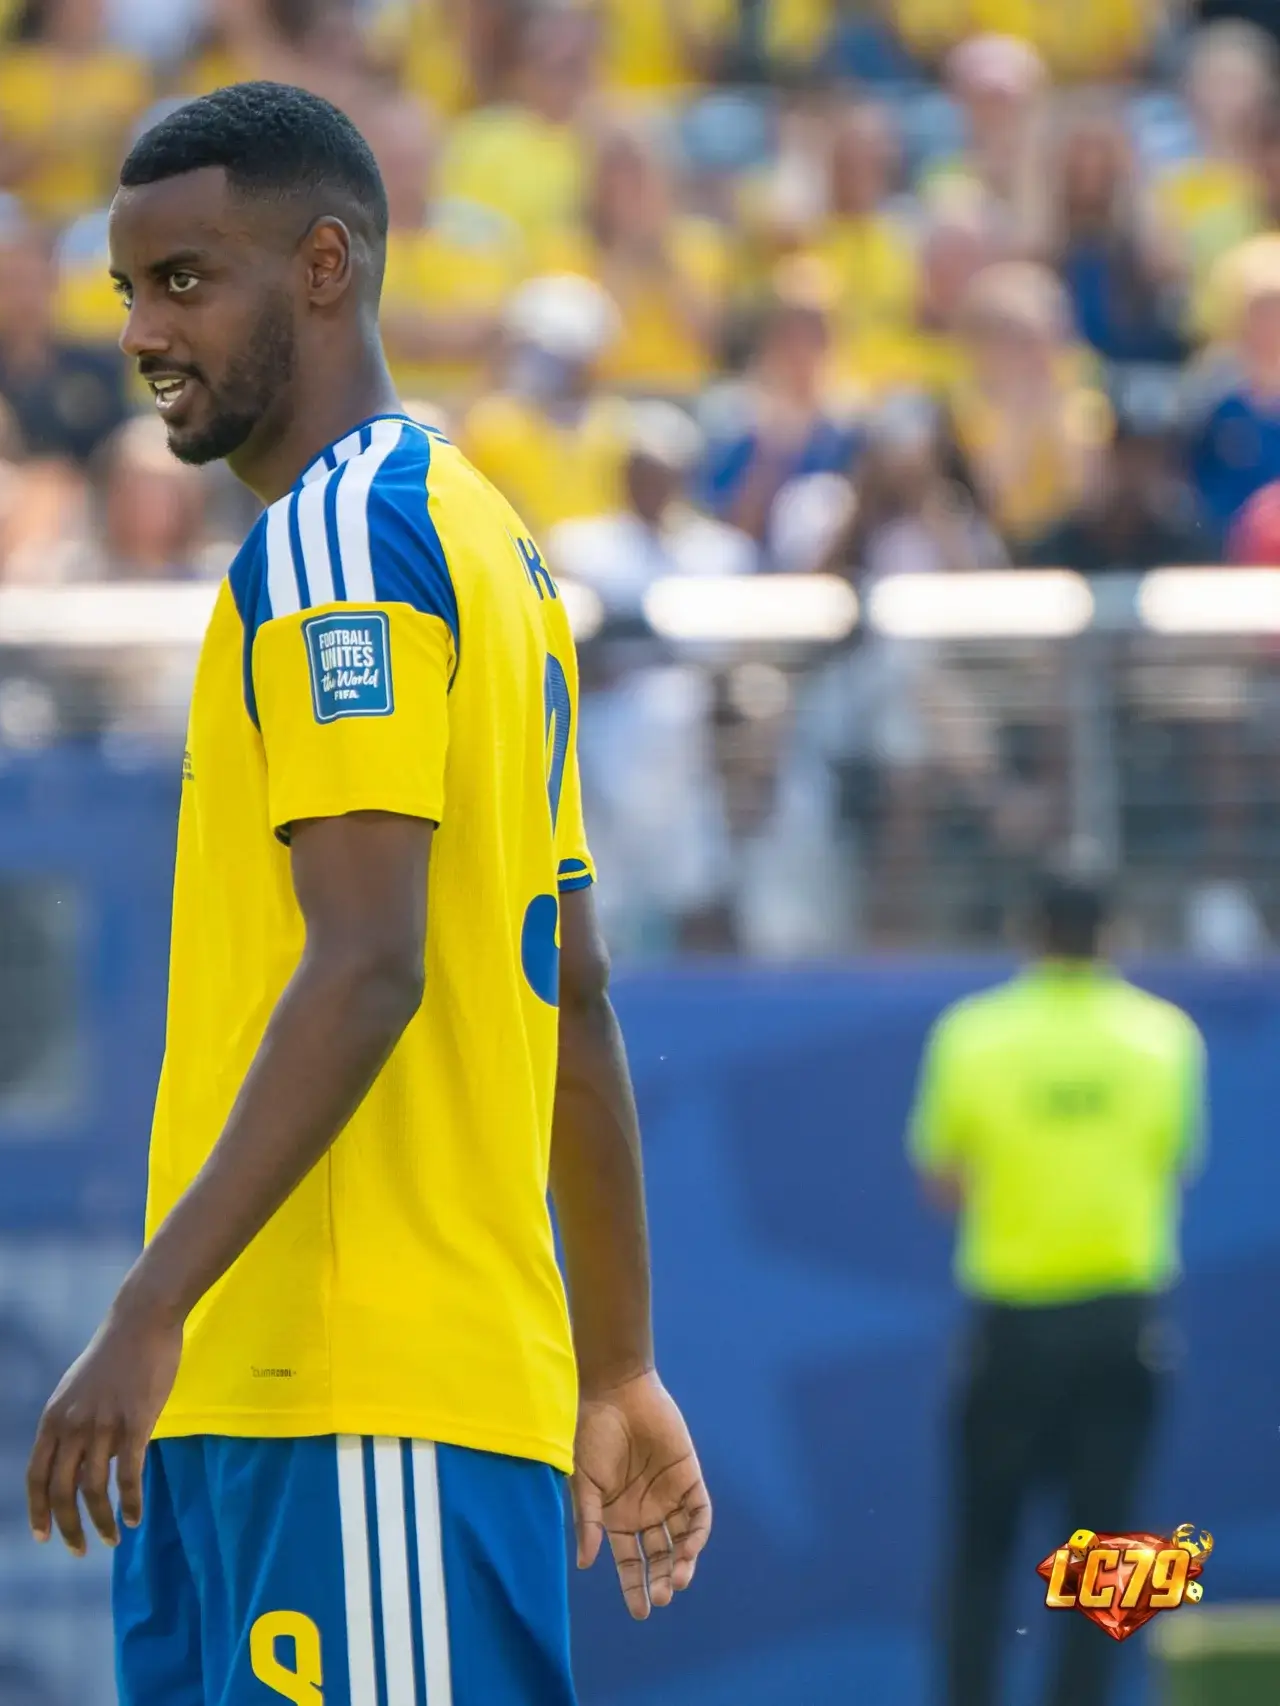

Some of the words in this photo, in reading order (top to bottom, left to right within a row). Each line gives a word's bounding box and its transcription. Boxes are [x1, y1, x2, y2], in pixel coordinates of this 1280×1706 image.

[319, 629, 373, 650] FOOTBALL
[321, 646, 375, 672] UNITES
[321, 672, 336, 692] the
[337, 668, 379, 688] World
[334, 689, 357, 700] FIFA
